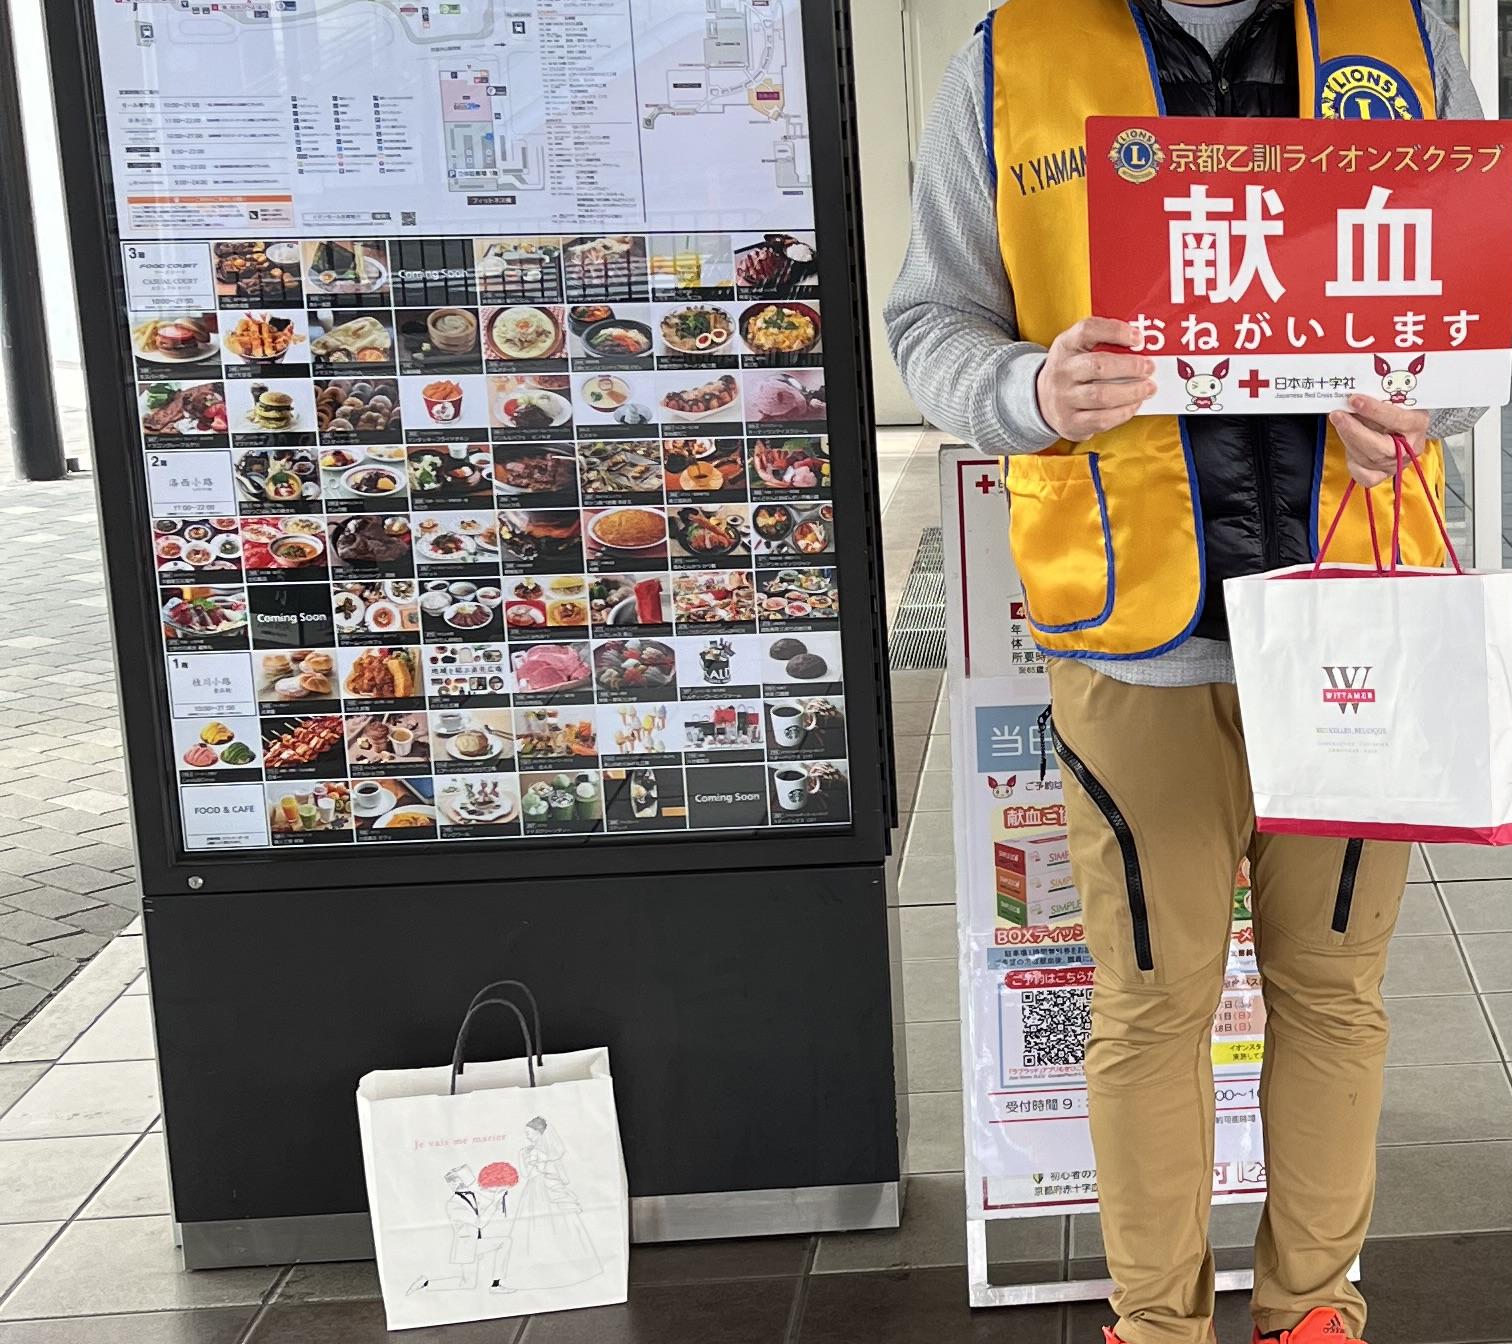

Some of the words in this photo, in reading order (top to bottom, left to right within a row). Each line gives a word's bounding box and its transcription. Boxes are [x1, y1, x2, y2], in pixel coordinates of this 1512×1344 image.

[1333, 68, 1393, 94] LIONS
[1119, 129, 1153, 143] LIONS
[1131, 146, 1145, 165] L
[1168, 142, 1504, 173] 京都乙訓ライオンズクラブ
[1163, 184, 1443, 304] 献血
[1130, 309, 1481, 352] おねがいします
[1274, 376, 1356, 390] 日本赤十字社
[257, 613, 297, 624] Coming
[299, 611, 328, 622] Soon
[1322, 666, 1373, 715] W
[695, 793, 733, 804] Coming
[735, 791, 760, 802] Soon
[194, 806, 221, 815] FOOD
[232, 804, 255, 813] CAFE
[1006, 1098, 1058, 1113] 受付時間
